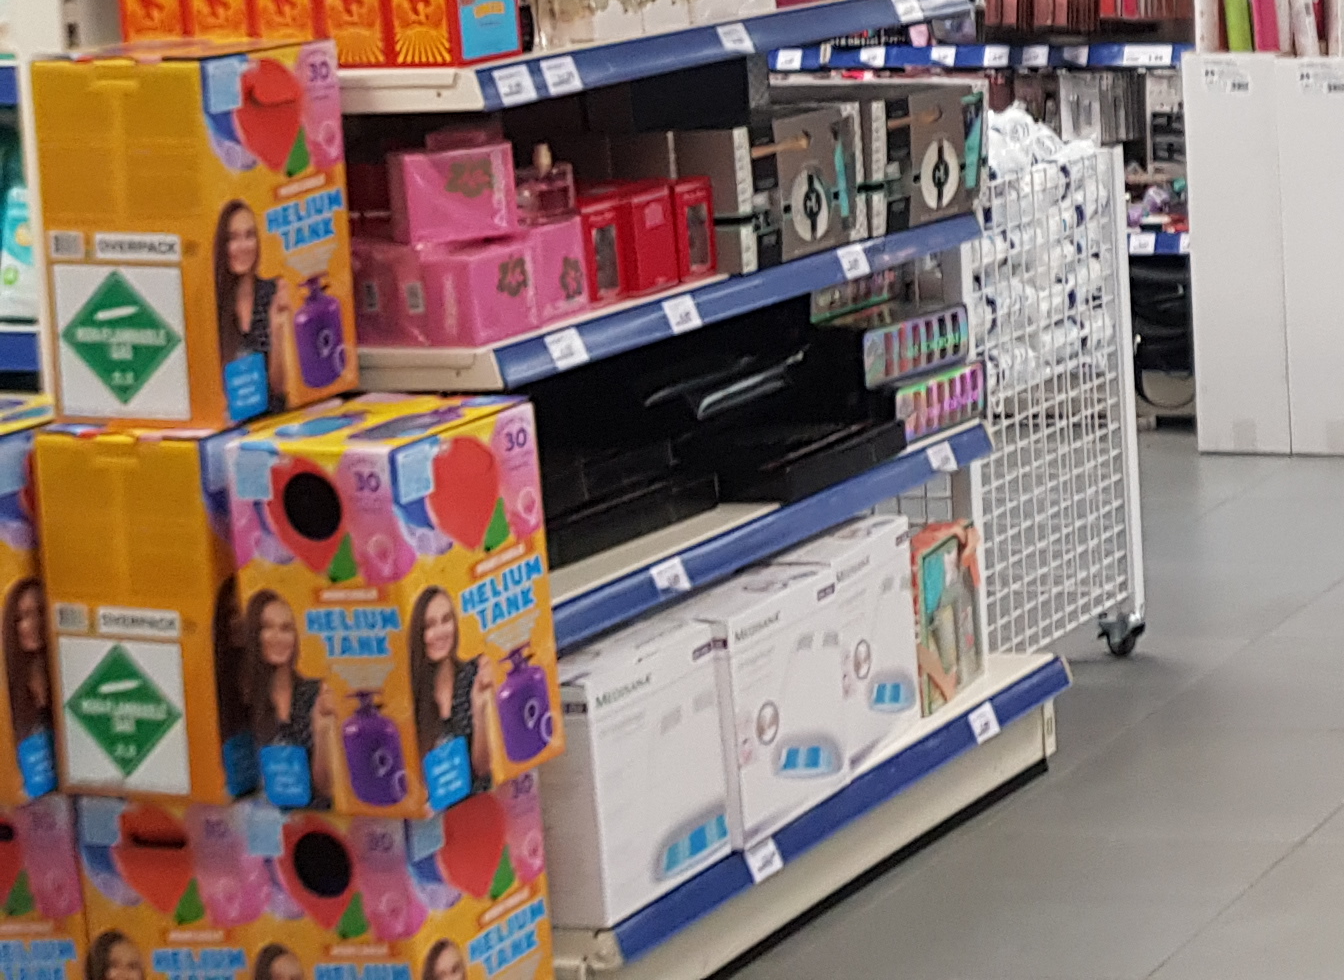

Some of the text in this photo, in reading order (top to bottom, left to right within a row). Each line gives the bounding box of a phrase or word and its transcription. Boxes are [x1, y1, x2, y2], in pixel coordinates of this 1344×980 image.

[310, 60, 329, 83] 30
[265, 188, 343, 234] HELIUM
[280, 218, 335, 252] TANK
[505, 428, 528, 451] 30
[355, 472, 381, 493] 30
[460, 555, 543, 614] HELIUM
[305, 608, 401, 633] HELIUM
[475, 586, 536, 631] TANK
[323, 634, 390, 658] TANK
[468, 898, 546, 963] HELIUM
[482, 929, 540, 977] TANK
